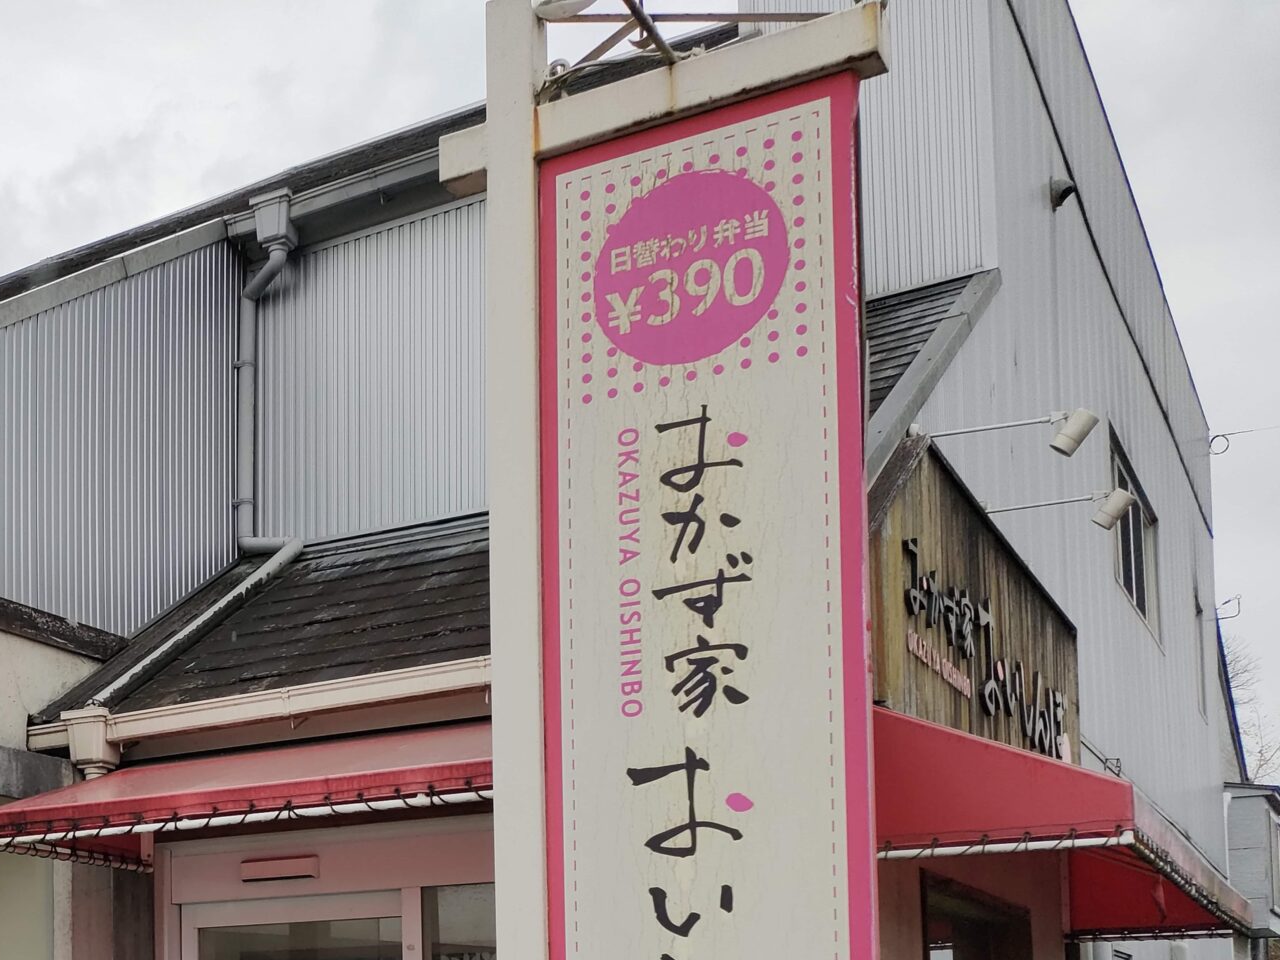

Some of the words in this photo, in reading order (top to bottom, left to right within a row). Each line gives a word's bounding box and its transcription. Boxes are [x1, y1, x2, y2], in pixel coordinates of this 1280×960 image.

[605, 248, 765, 335] ¥390
[611, 210, 769, 274] 日替わり弁当
[617, 427, 641, 565] OKAZUYA
[652, 404, 754, 718] おかず家
[618, 578, 644, 718] OISHINBO
